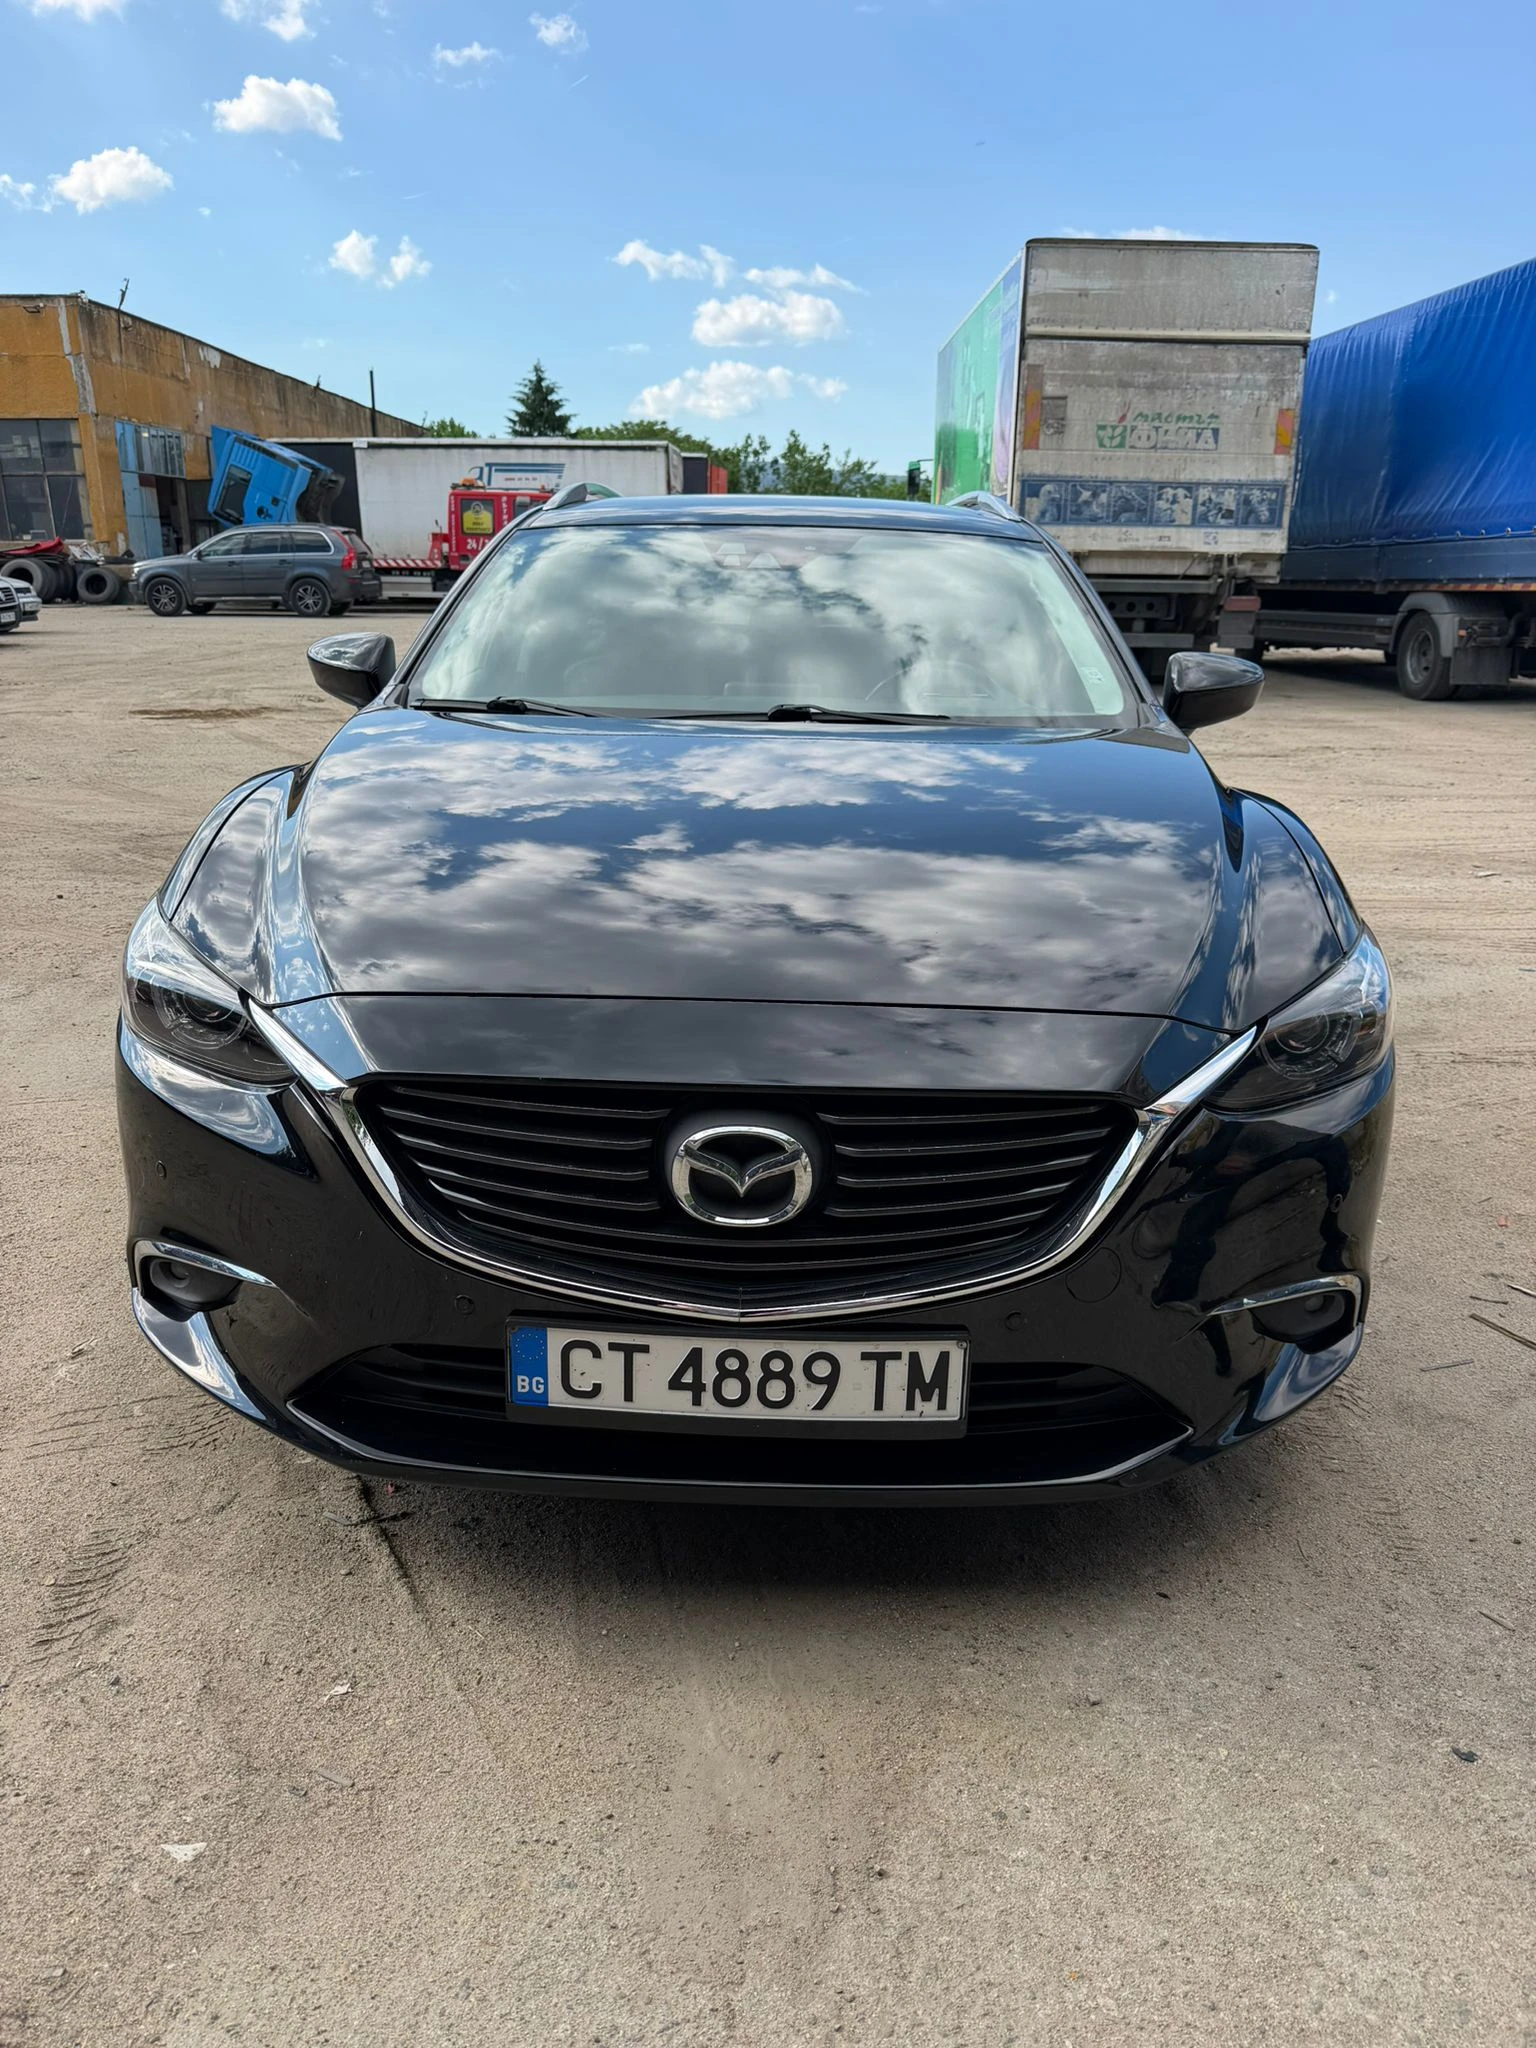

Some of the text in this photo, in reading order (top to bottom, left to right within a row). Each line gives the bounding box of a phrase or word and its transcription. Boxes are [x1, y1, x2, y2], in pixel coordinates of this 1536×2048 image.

[516, 1374, 546, 1395] BG
[560, 1339, 950, 1412] CT 4889 TM
